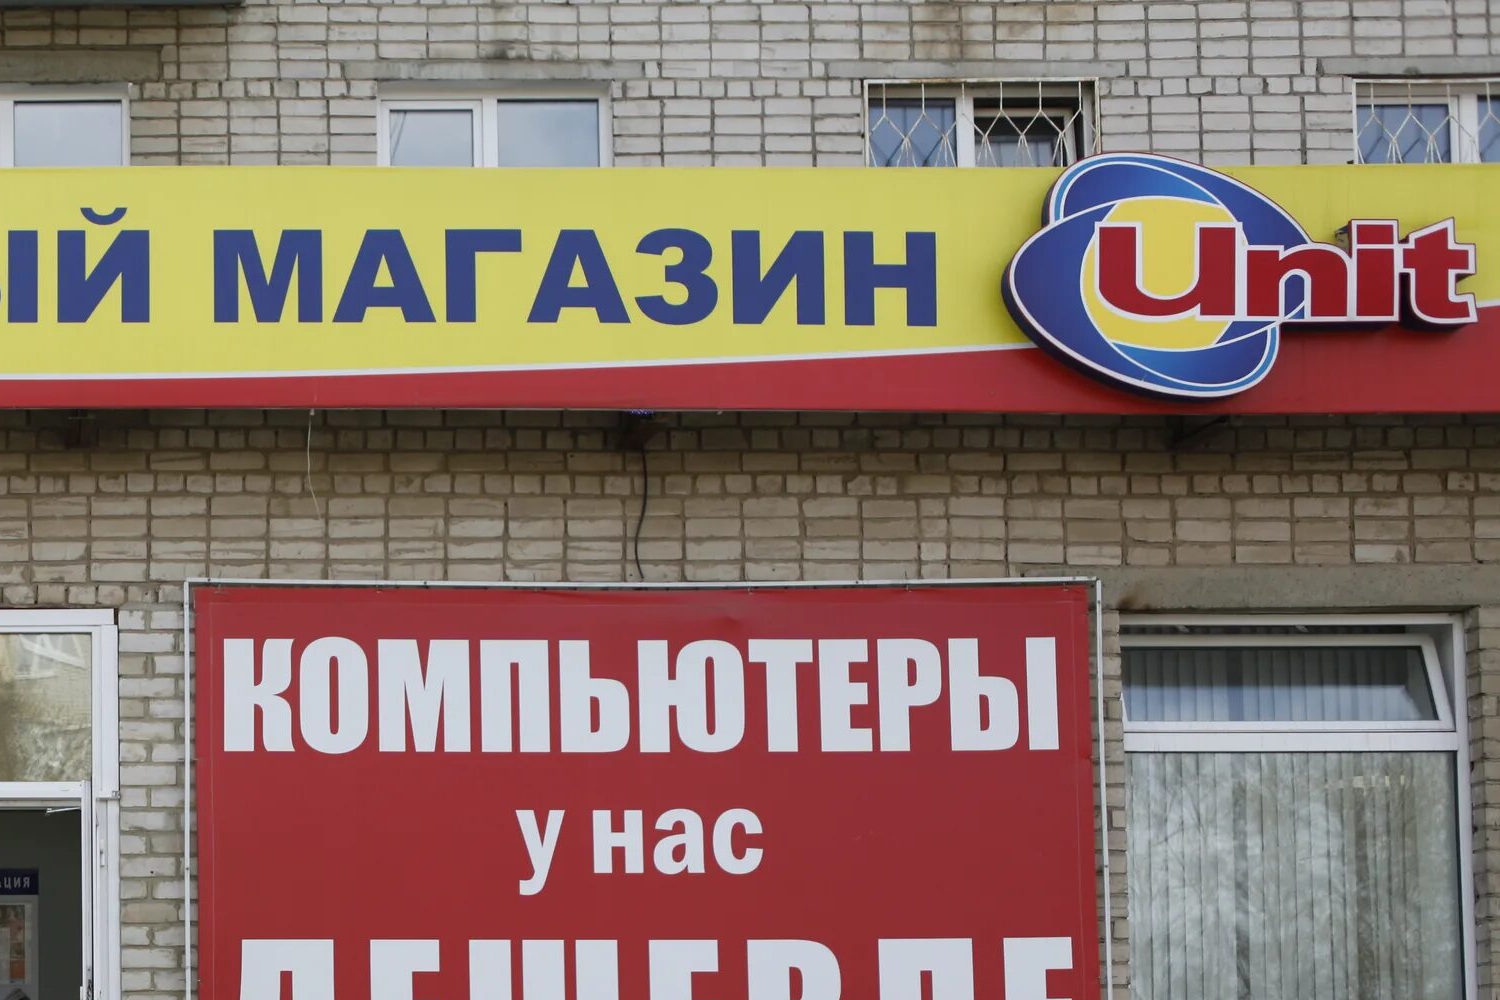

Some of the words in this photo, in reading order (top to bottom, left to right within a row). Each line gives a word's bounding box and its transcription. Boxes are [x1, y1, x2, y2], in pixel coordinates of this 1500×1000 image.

[213, 228, 938, 327] МАГАЗИН
[1093, 217, 1478, 324] Unit
[223, 636, 1060, 755] КОМПЬЮТЕРЫ
[515, 809, 565, 896] у
[592, 808, 764, 876] нас
